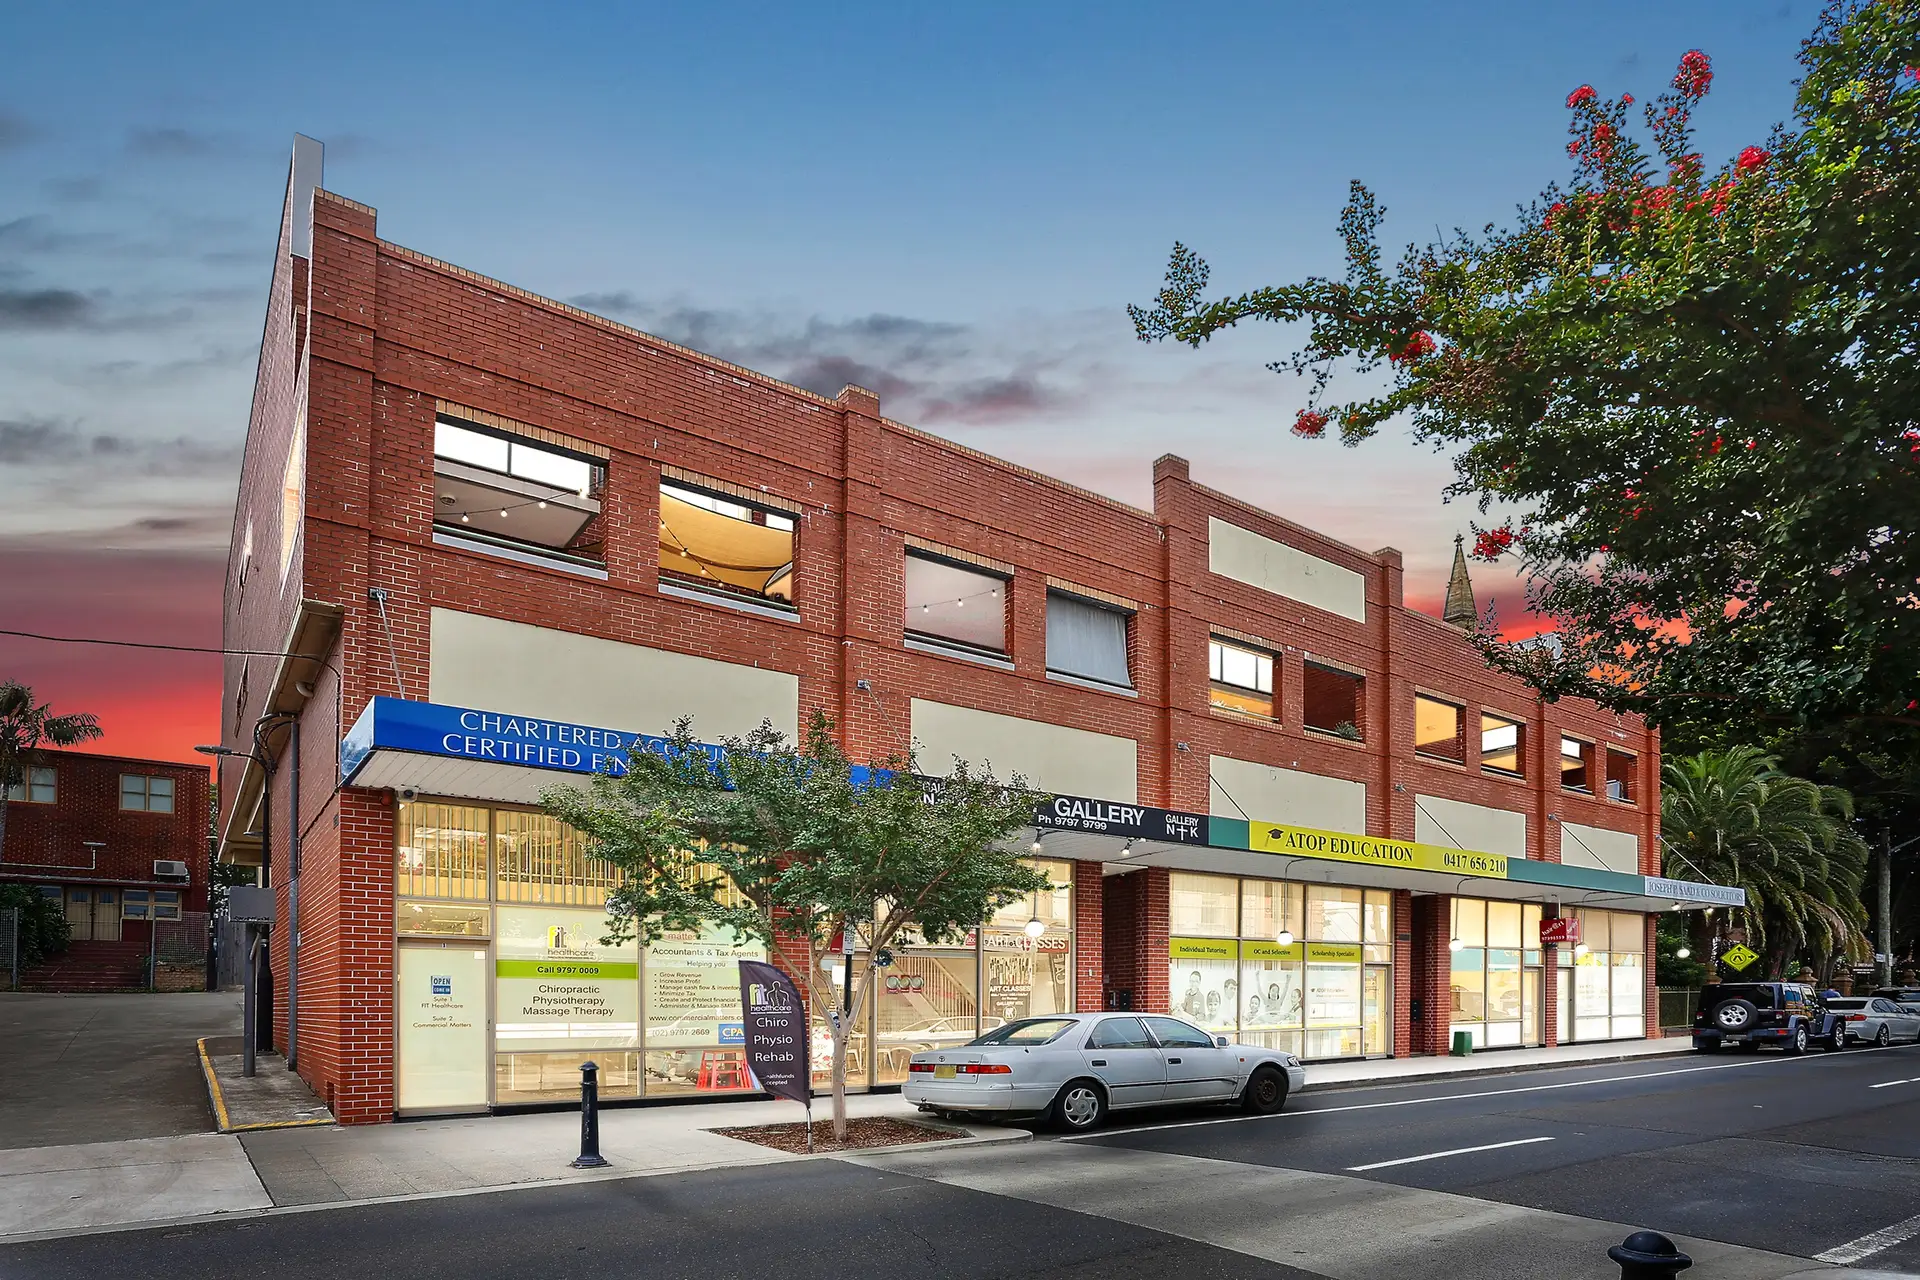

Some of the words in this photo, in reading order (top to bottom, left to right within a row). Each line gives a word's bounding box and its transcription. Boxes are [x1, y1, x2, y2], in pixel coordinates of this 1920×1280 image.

[460, 711, 621, 750] CHARTERED
[442, 733, 581, 767] CERTIFIED
[1054, 797, 1145, 826] GALLERY
[1038, 814, 1052, 824] Ph
[1055, 816, 1080, 827] 9797
[1082, 819, 1107, 830] 9799
[1165, 813, 1199, 826] GALLERY
[1285, 832, 1327, 851] ATOP
[1330, 837, 1413, 861] EDUCATION
[1444, 852, 1467, 868] 0417
[1470, 856, 1487, 871] 656
[1490, 859, 1505, 873] 210
[547, 948, 594, 957] healthcare
[652, 947, 705, 956] Accountants
[715, 949, 729, 957] Tax
[730, 950, 759, 958] Agents
[537, 966, 554, 974] Call
[556, 966, 577, 974] 9797
[686, 960, 713, 969] Helping
[538, 984, 600, 995] Chiropractic
[532, 996, 606, 1007] Physiotherapy
[522, 1006, 570, 1017] Massage
[573, 1006, 615, 1017] Therapy
[756, 1017, 788, 1028] Chiro
[652, 1029, 668, 1037] (02)
[670, 1029, 689, 1037] 9797
[722, 1028, 744, 1037] CPA
[754, 1034, 793, 1047] Physio
[755, 1051, 794, 1062] Rehab
